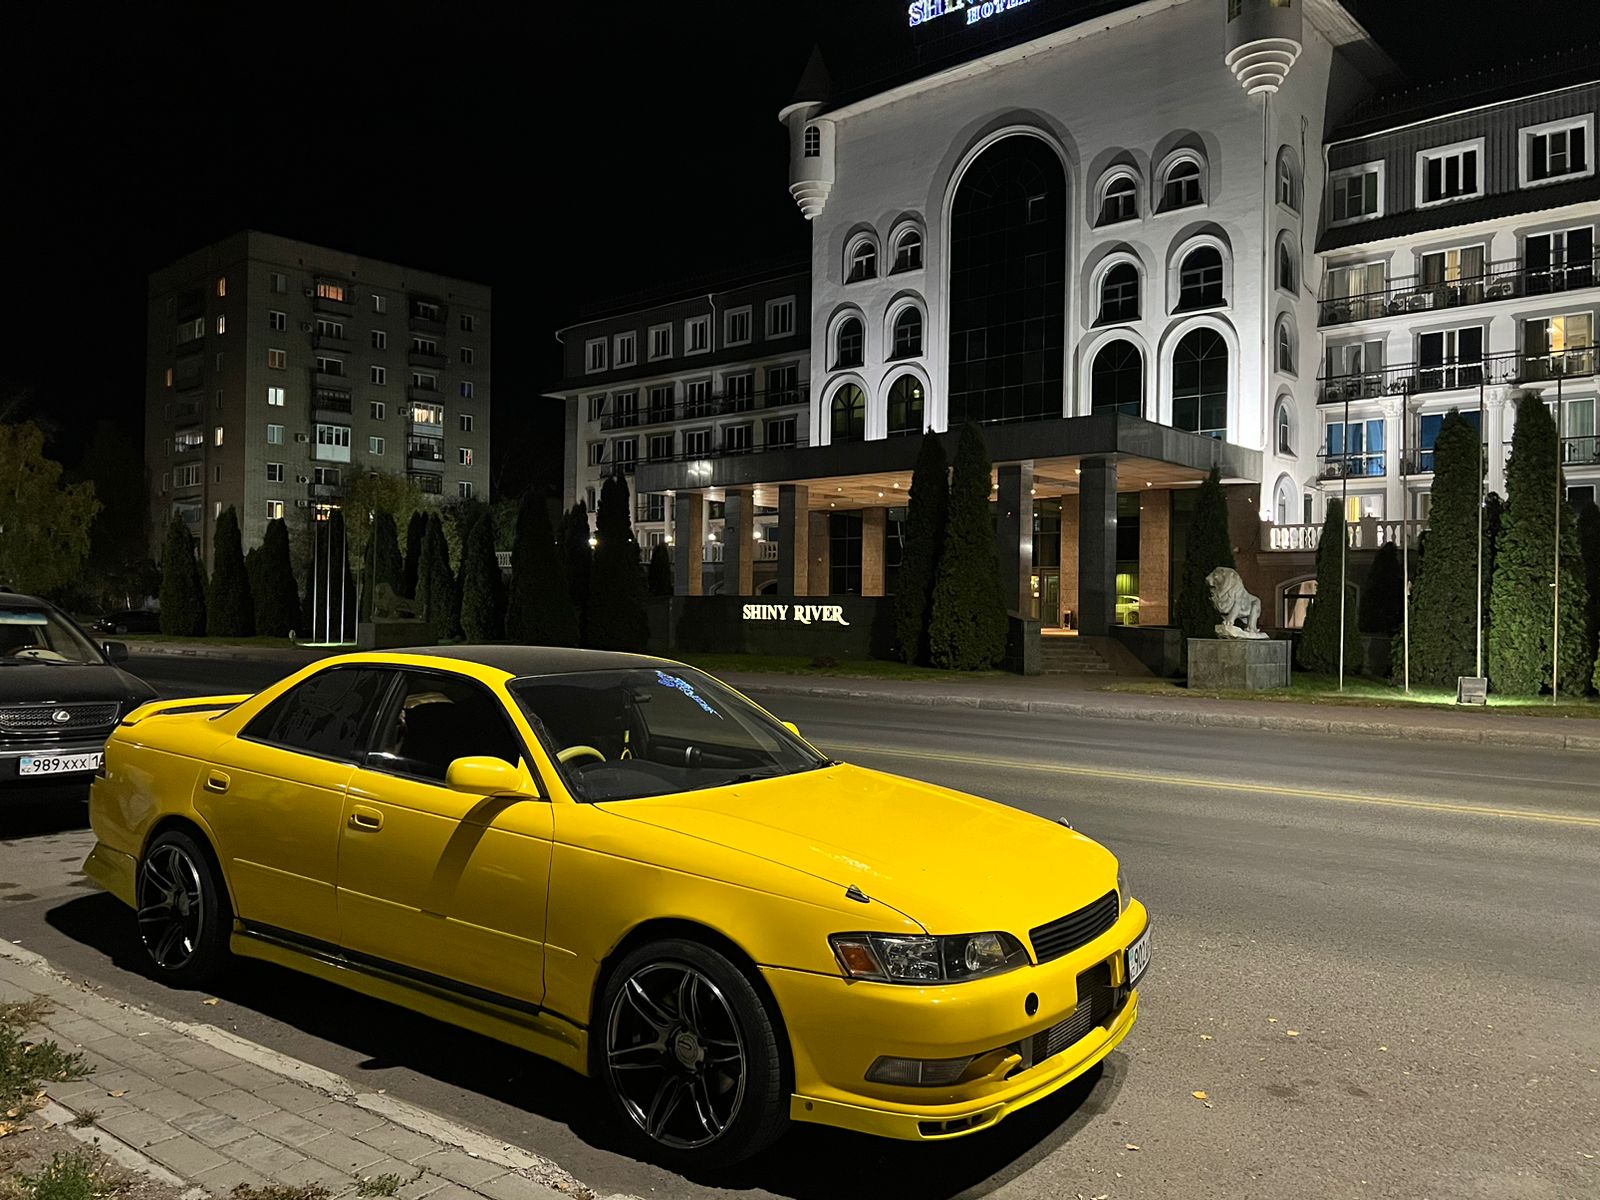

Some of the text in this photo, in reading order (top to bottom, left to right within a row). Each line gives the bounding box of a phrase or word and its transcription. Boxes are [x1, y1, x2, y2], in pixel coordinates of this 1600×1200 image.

[908, 0, 974, 27] SHI
[743, 604, 850, 625] SHINY RIVER
